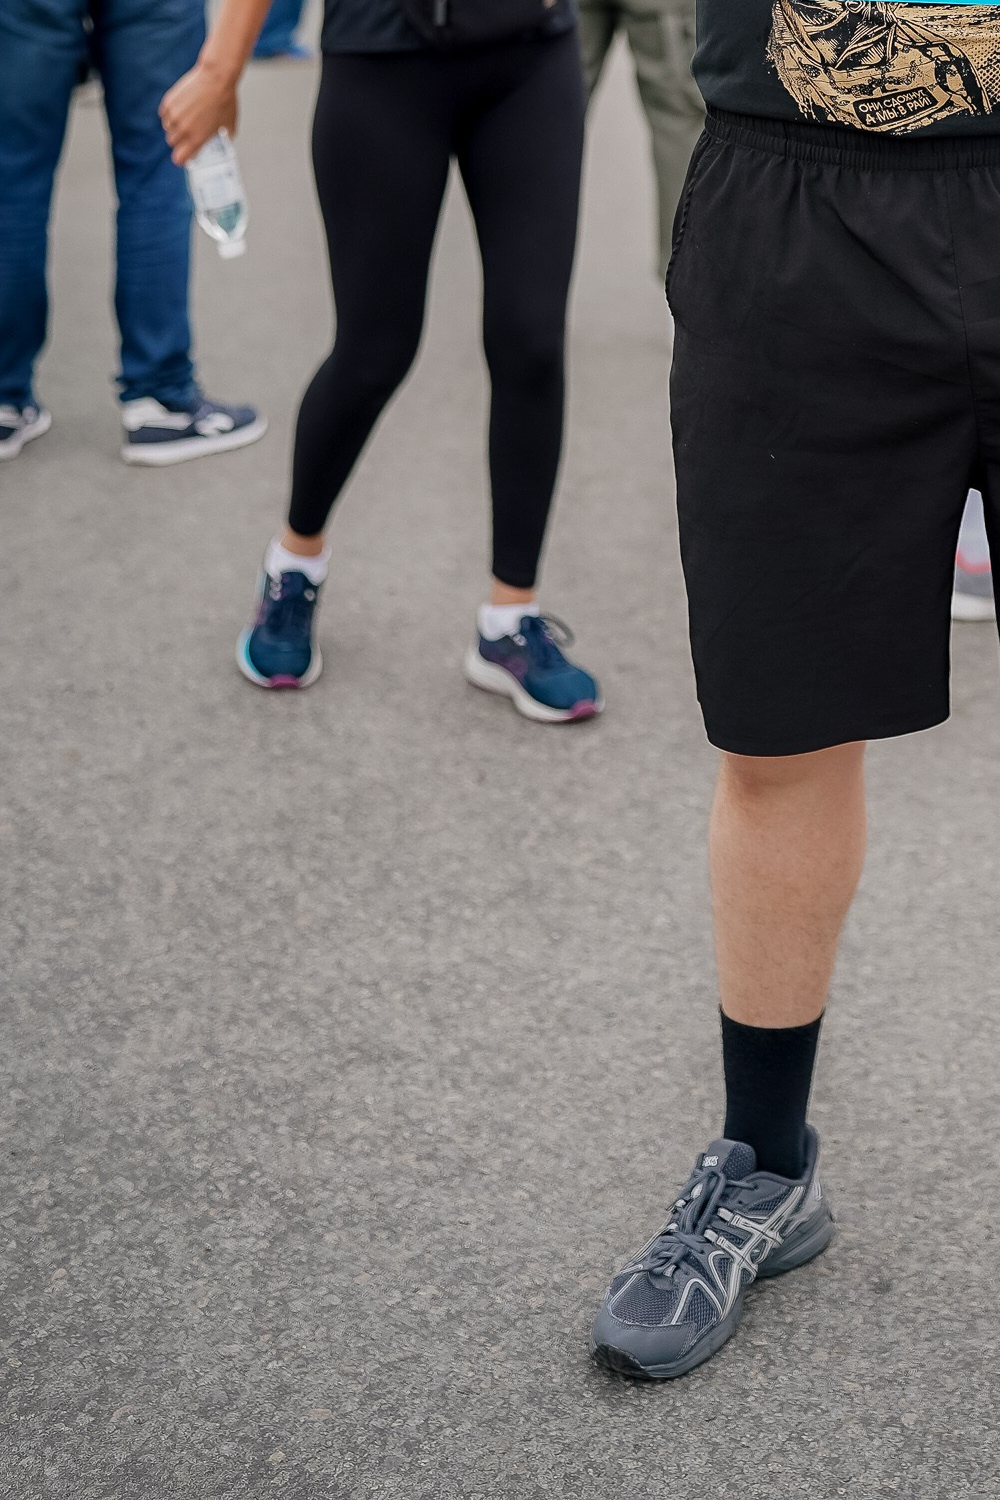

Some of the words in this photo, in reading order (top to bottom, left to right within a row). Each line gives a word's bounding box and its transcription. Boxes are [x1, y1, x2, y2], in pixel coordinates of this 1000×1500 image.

[858, 102, 884, 113] ОНИ
[865, 113, 877, 125] А
[875, 108, 898, 123] МЫ
[897, 105, 907, 116] В
[906, 96, 932, 112] РАЙ!
